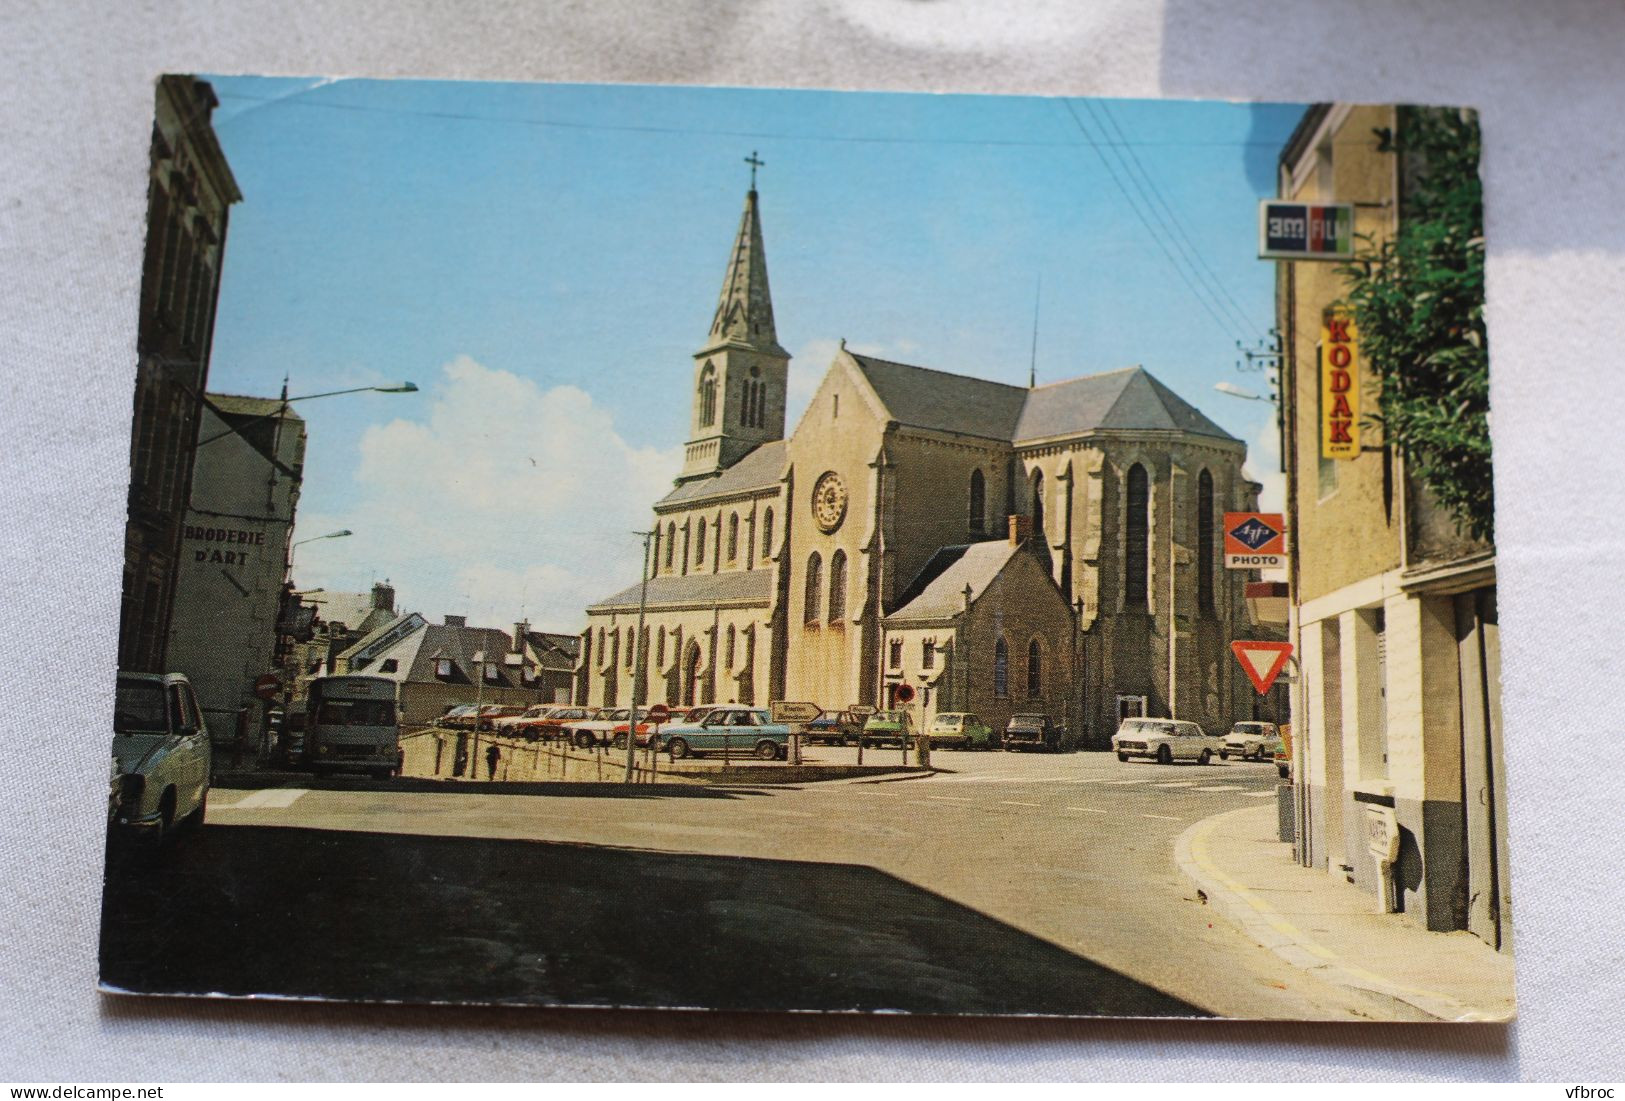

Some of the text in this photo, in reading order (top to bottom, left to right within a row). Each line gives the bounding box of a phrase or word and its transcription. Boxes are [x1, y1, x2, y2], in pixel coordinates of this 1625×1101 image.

[1329, 319, 1353, 443] KODAK
[184, 526, 265, 545] BRODERIE
[195, 548, 248, 565] D'ART
[1232, 556, 1278, 565] PHOTO
